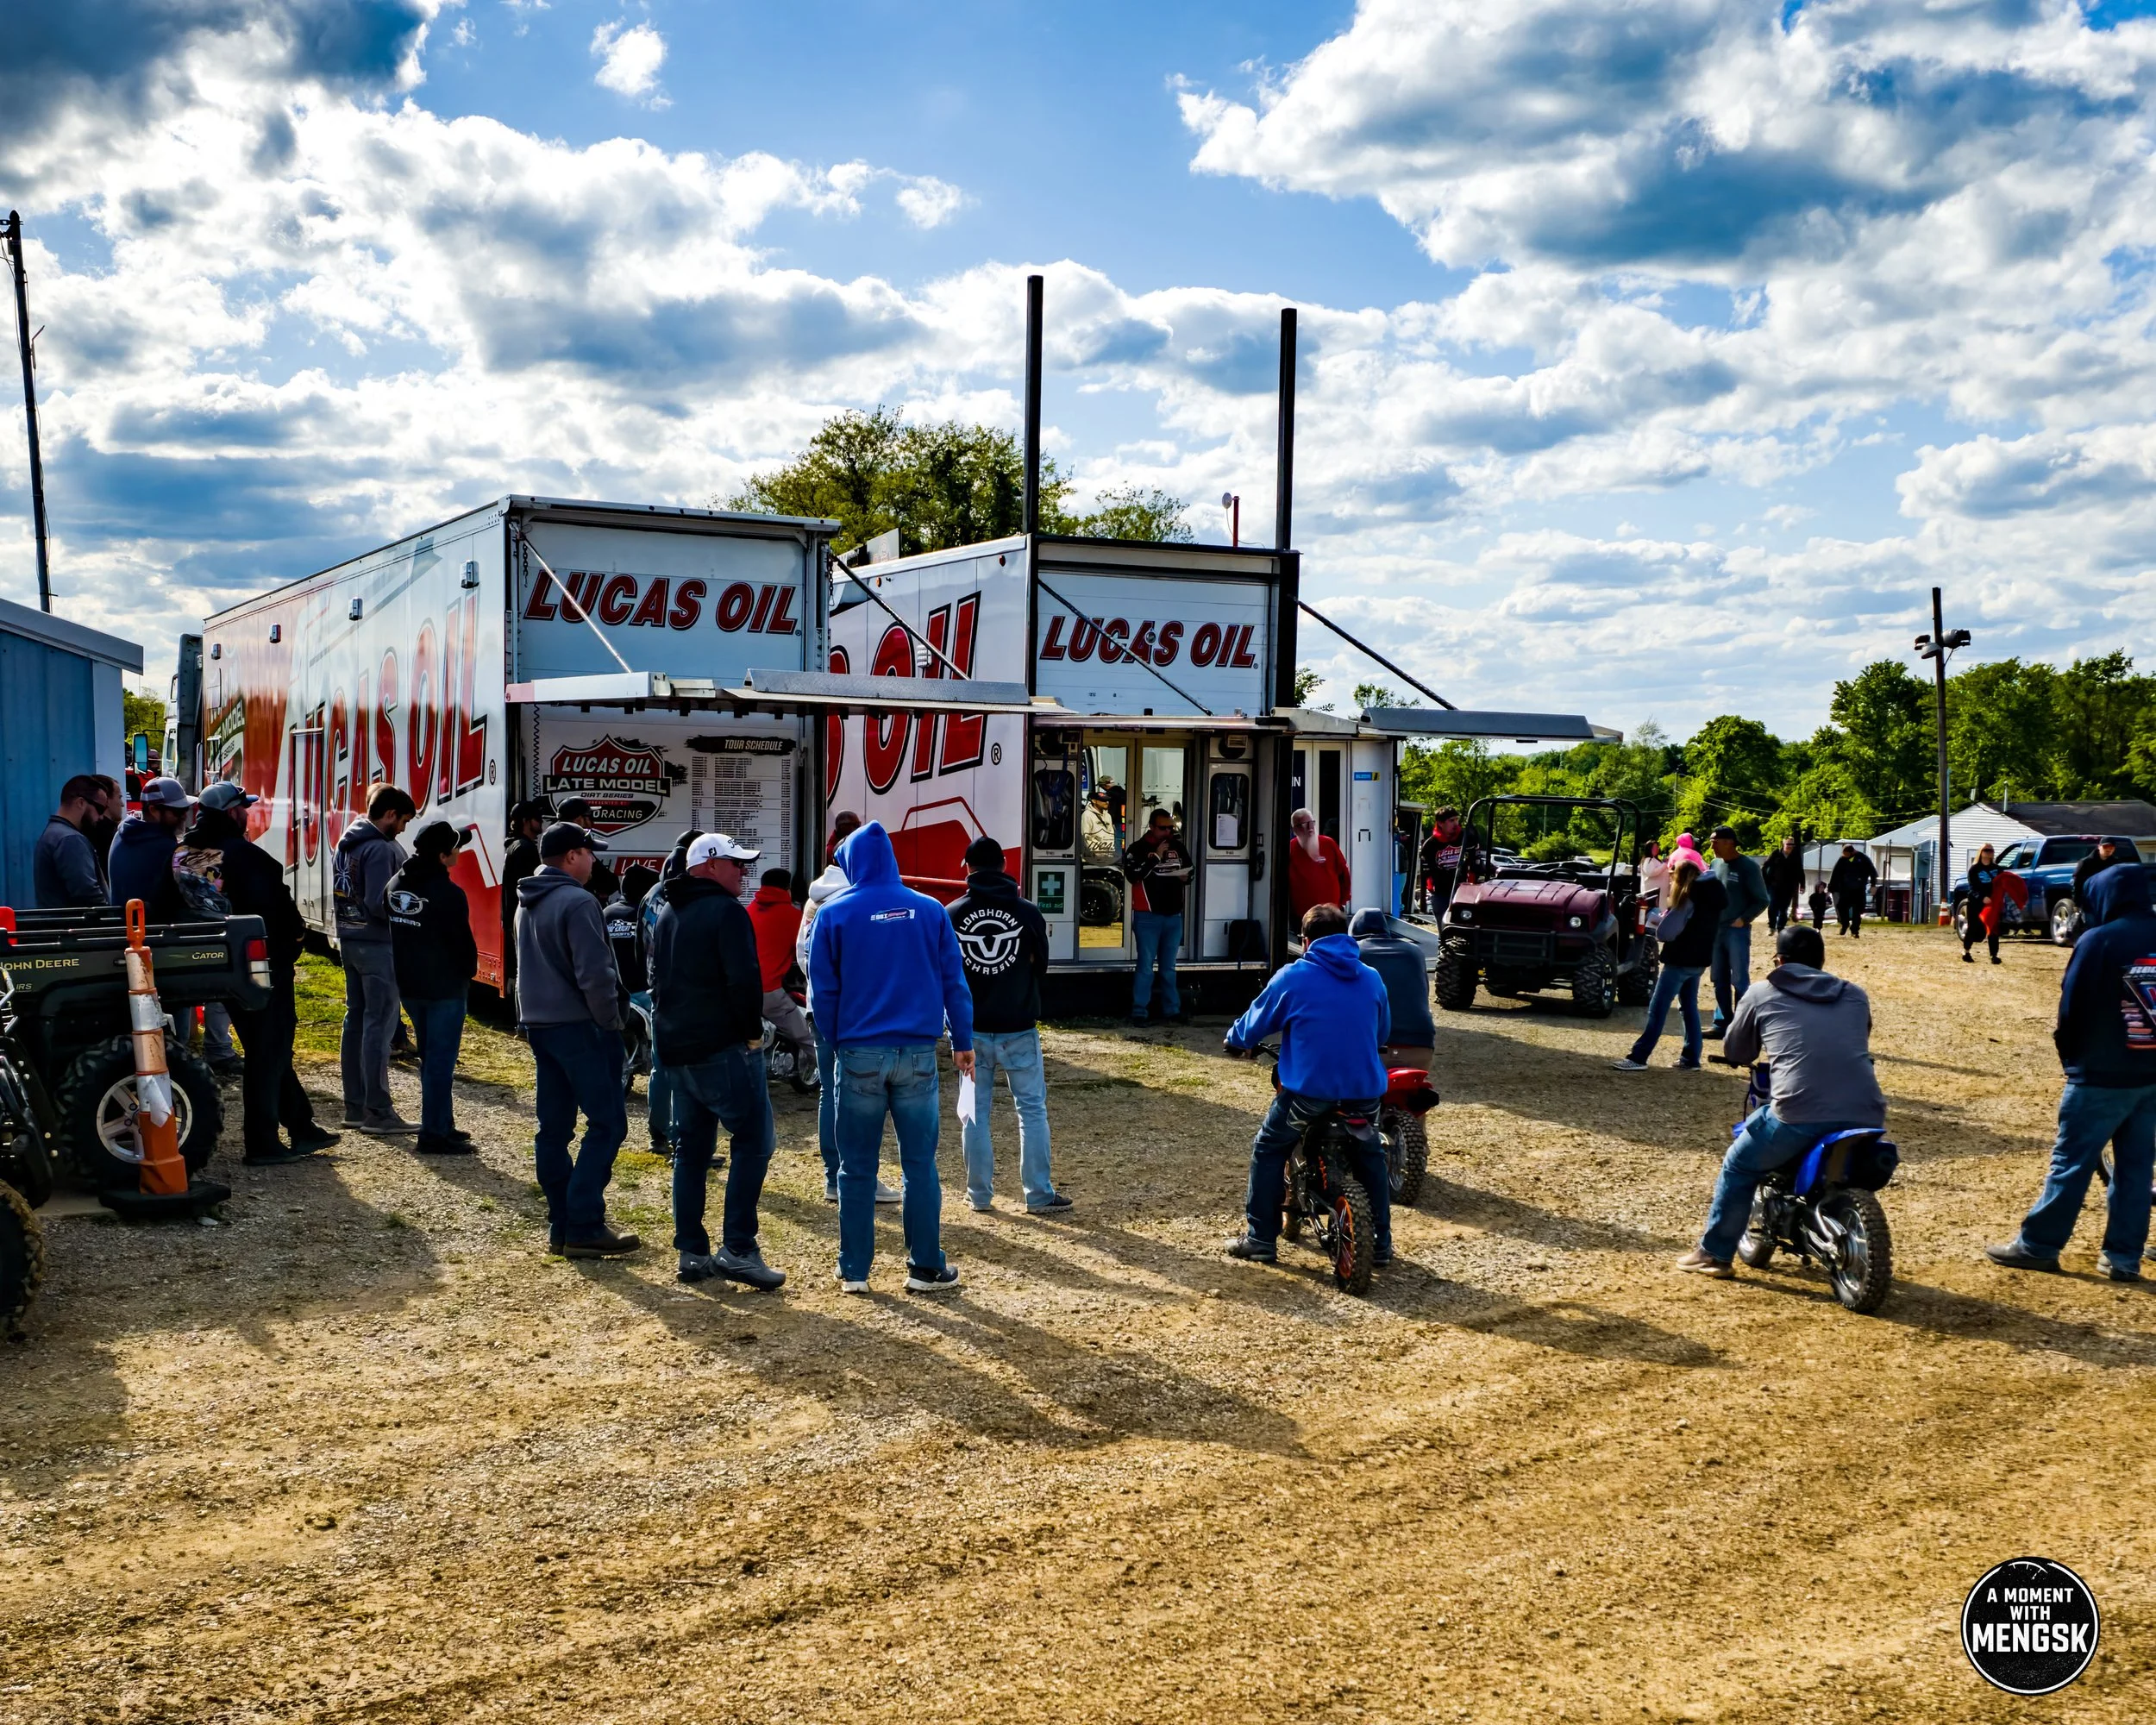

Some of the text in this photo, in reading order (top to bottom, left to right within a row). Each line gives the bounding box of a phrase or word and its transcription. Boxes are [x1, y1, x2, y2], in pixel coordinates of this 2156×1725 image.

[523, 569, 798, 635] LUCAS OIL
[1039, 615, 1257, 668] LUCAS OIL
[407, 586, 488, 819] OIL
[863, 590, 988, 796] OIL
[724, 739, 783, 750] TOUR SCHEDULE
[285, 645, 400, 875] LUCAS
[561, 756, 652, 775] LUCAS OIL
[546, 777, 667, 794] LATE MODEL
[592, 809, 642, 819] ORACING
[959, 908, 1018, 932] LONGHORN
[0, 958, 79, 971] JOHN DEERE
[191, 951, 224, 960] GATOR
[964, 954, 1017, 975] CHASSIS
